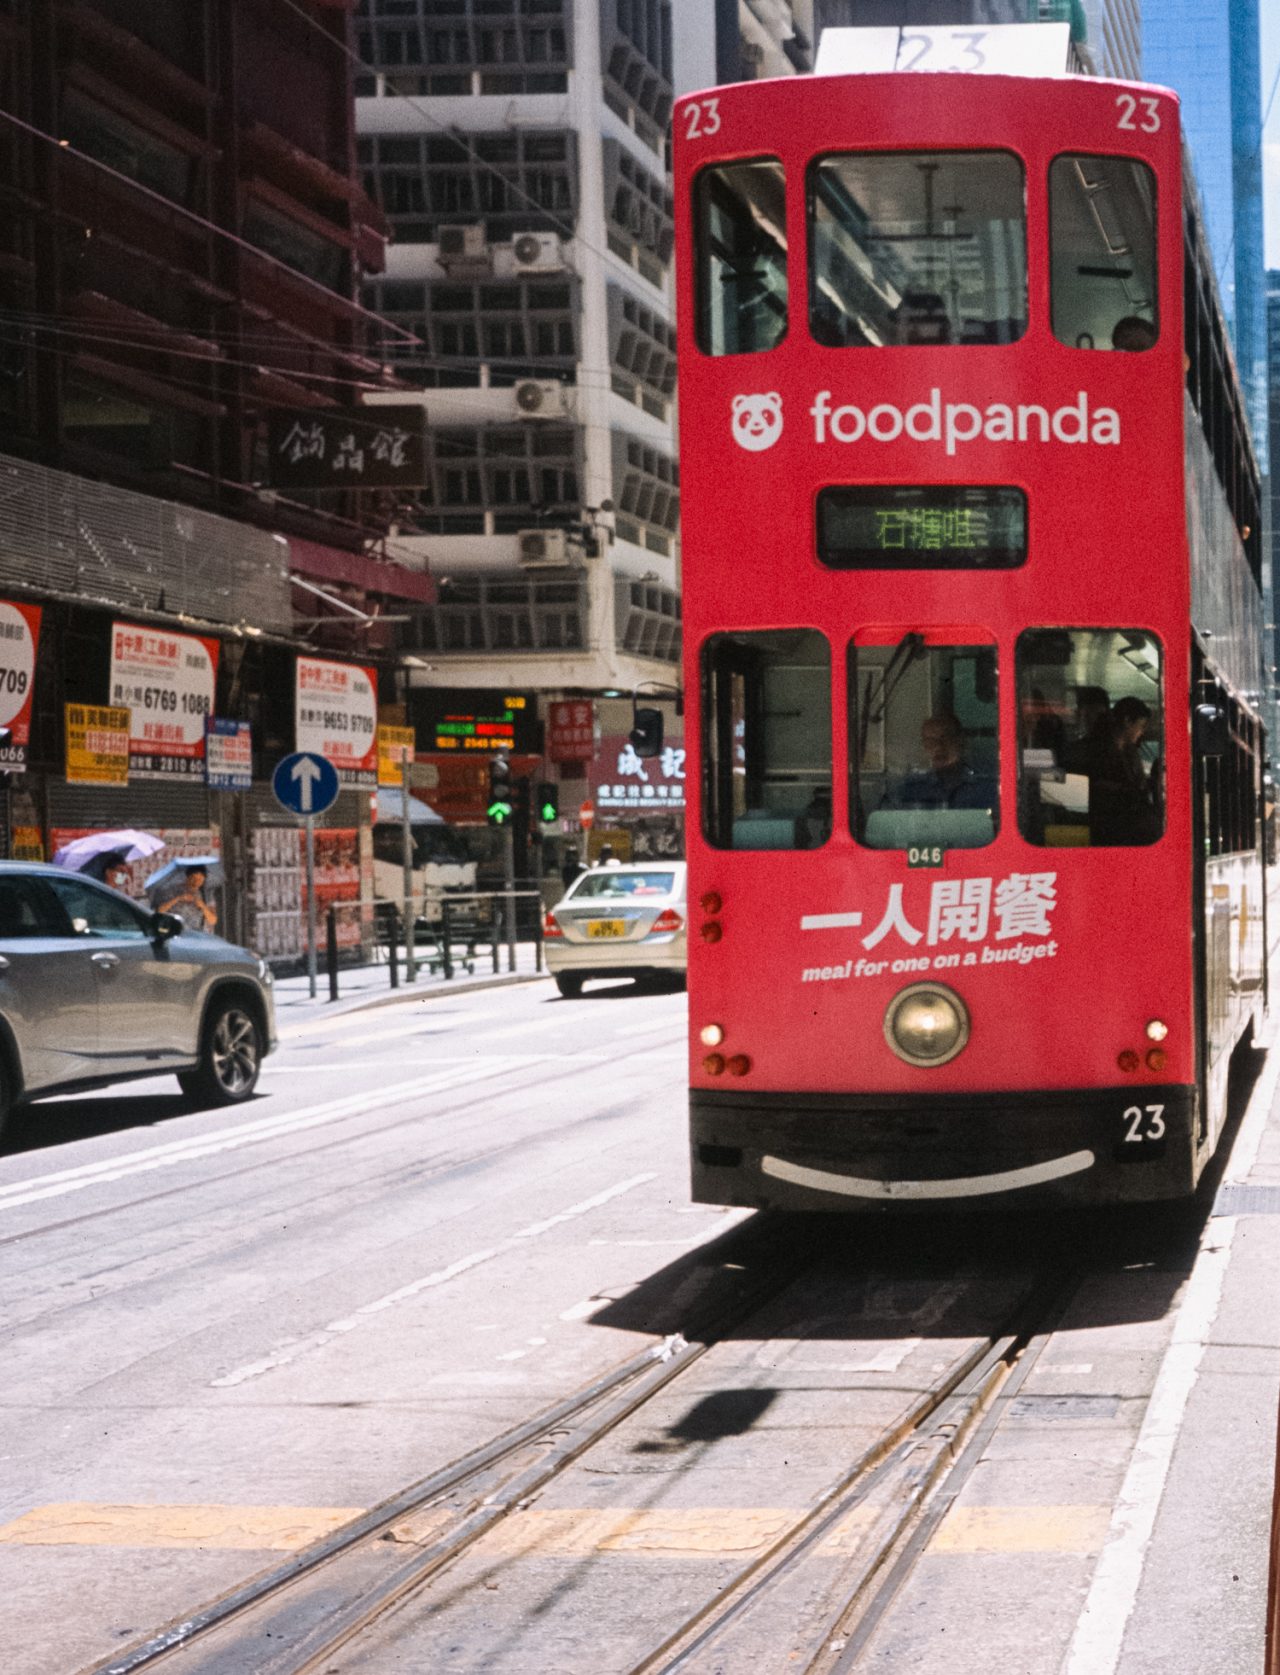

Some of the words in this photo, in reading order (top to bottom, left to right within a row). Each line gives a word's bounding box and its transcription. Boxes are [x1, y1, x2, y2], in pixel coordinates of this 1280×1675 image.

[899, 32, 988, 72] 23
[683, 98, 722, 140] 23
[1115, 94, 1161, 134] 23
[809, 388, 1121, 456] foodpanda
[144, 686, 178, 711] 6769
[908, 847, 942, 865] 046
[800, 871, 1058, 952] 一人開餐
[801, 960, 851, 983] meal
[854, 958, 889, 978] for
[892, 955, 931, 974] one
[933, 951, 961, 969] on
[963, 951, 977, 966] a
[981, 940, 1059, 965] budget
[1123, 1104, 1167, 1143] 23
